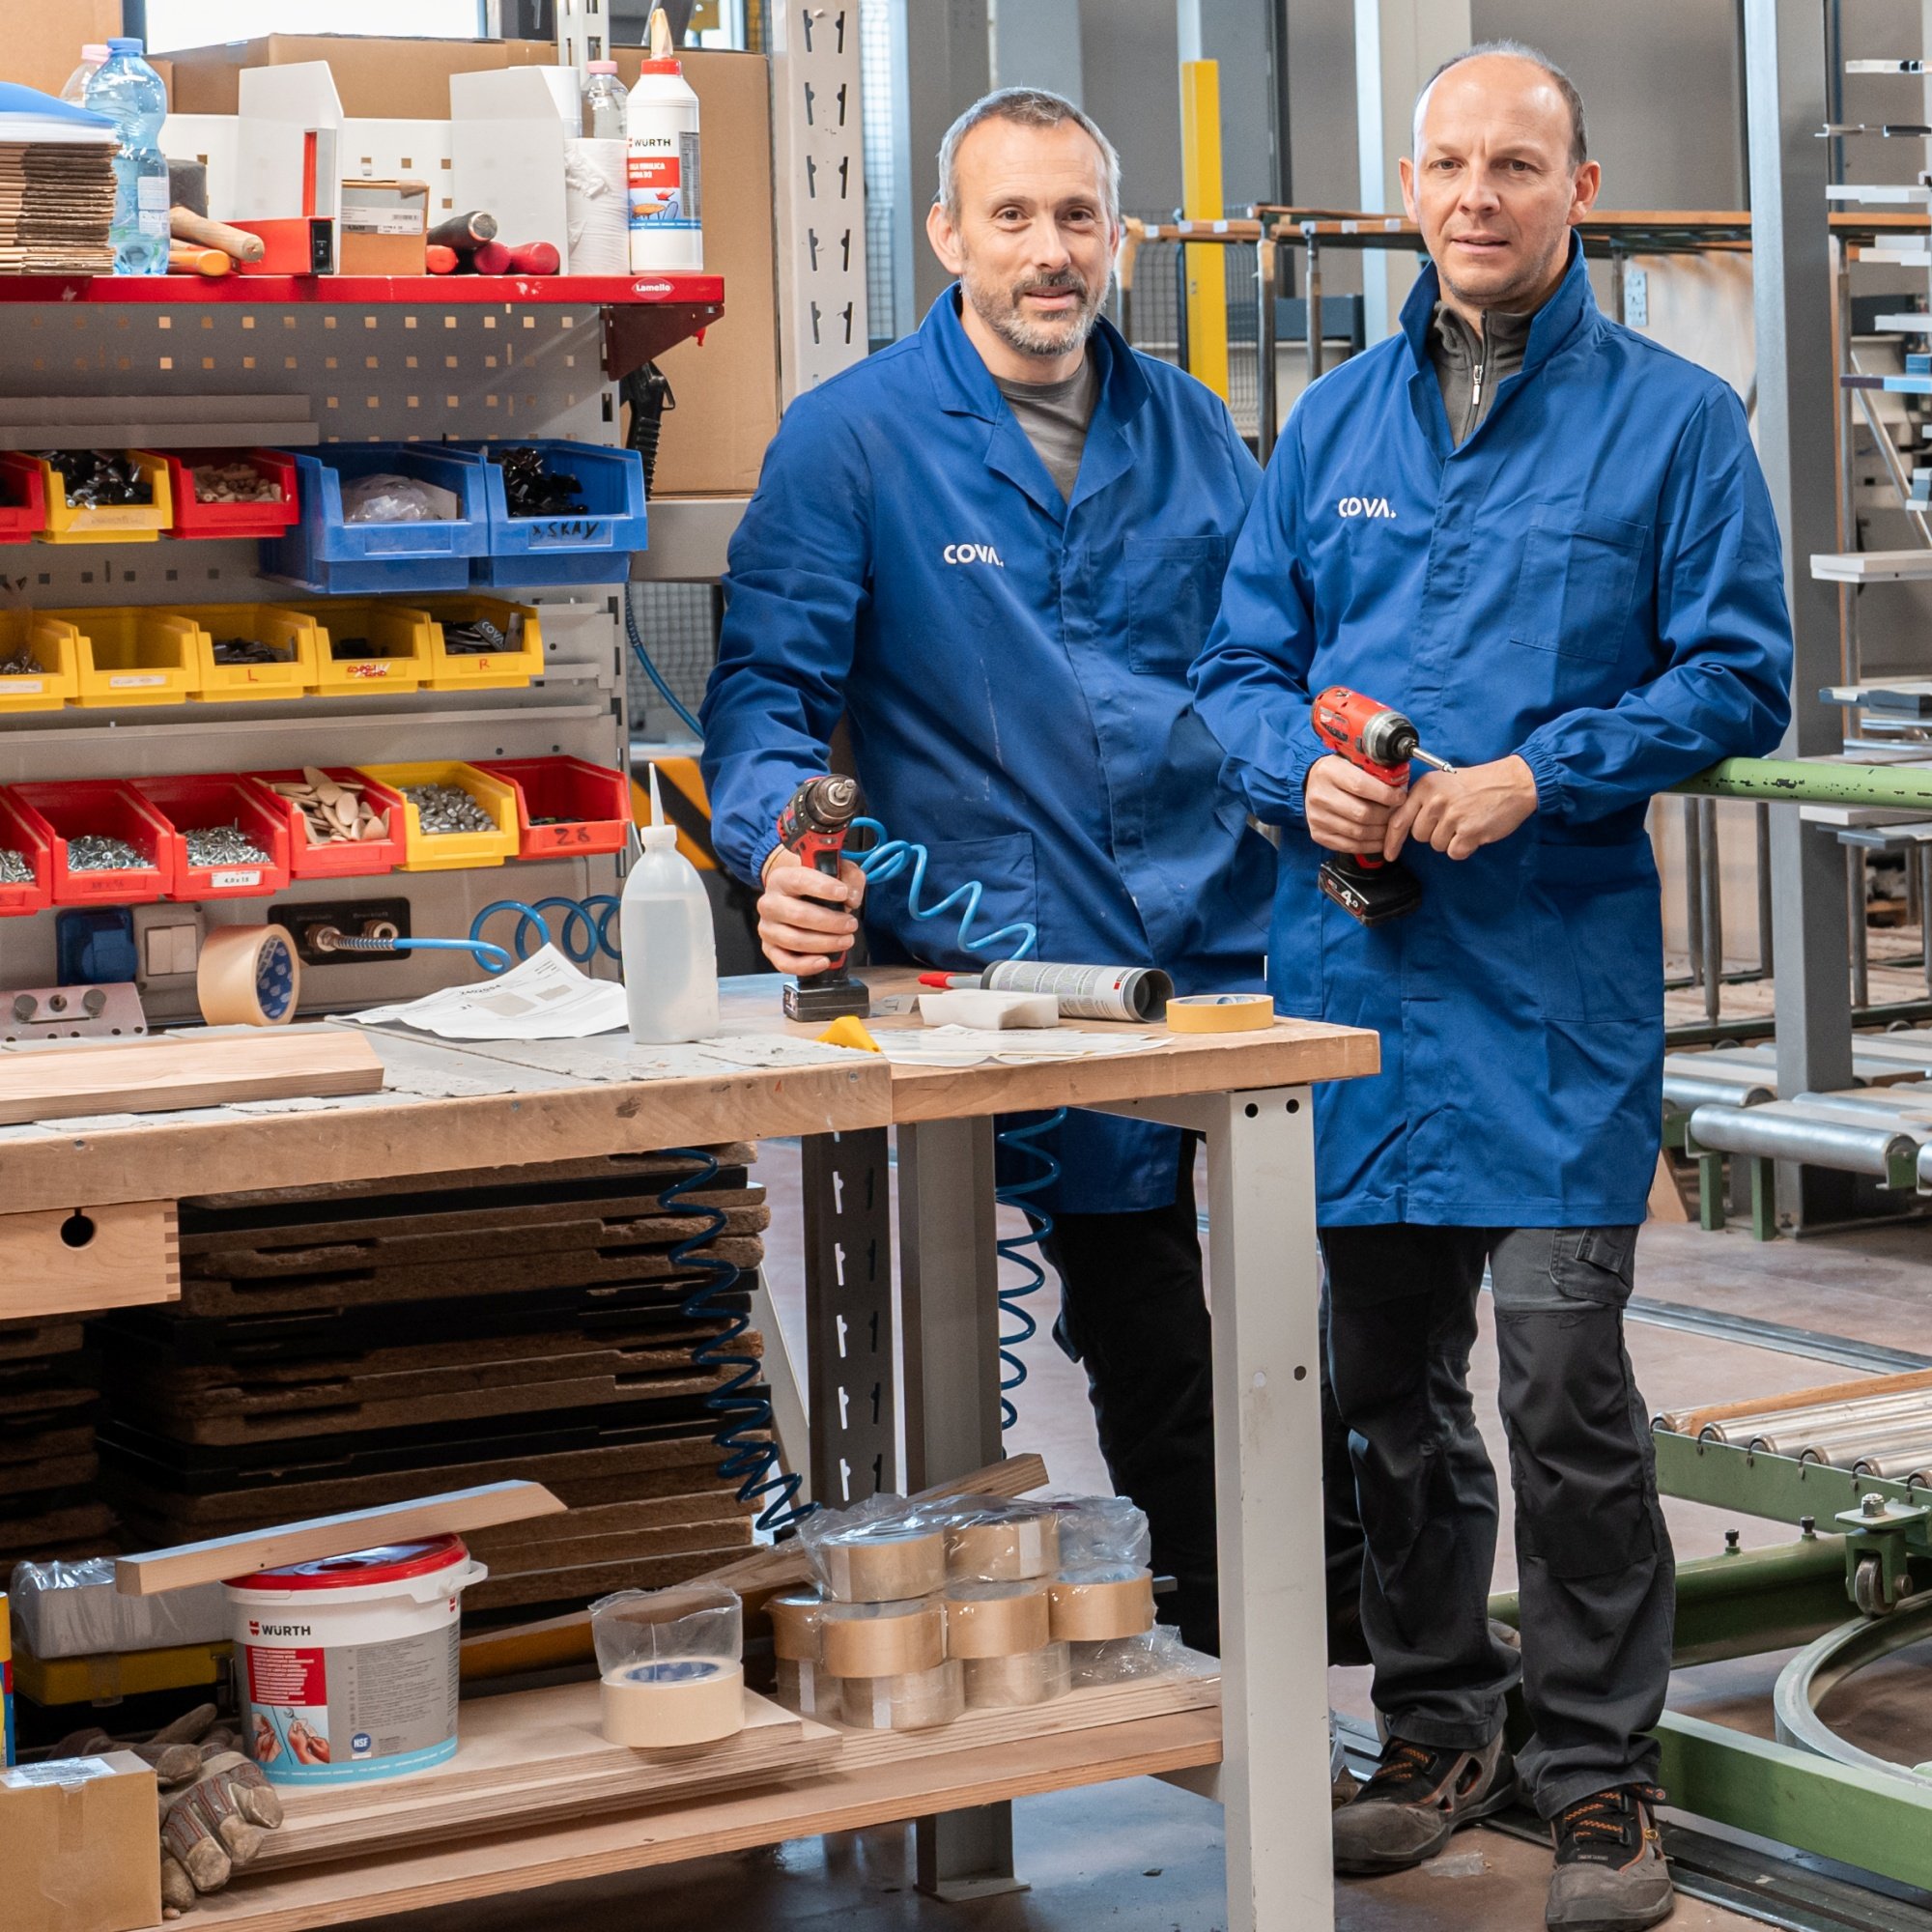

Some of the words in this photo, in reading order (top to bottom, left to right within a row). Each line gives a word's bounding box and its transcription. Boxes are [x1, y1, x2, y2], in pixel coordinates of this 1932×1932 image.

[636, 283, 671, 292] Lamello
[479, 658, 491, 670] R
[247, 668, 259, 682] L
[354, 1737, 369, 1748] NSF
